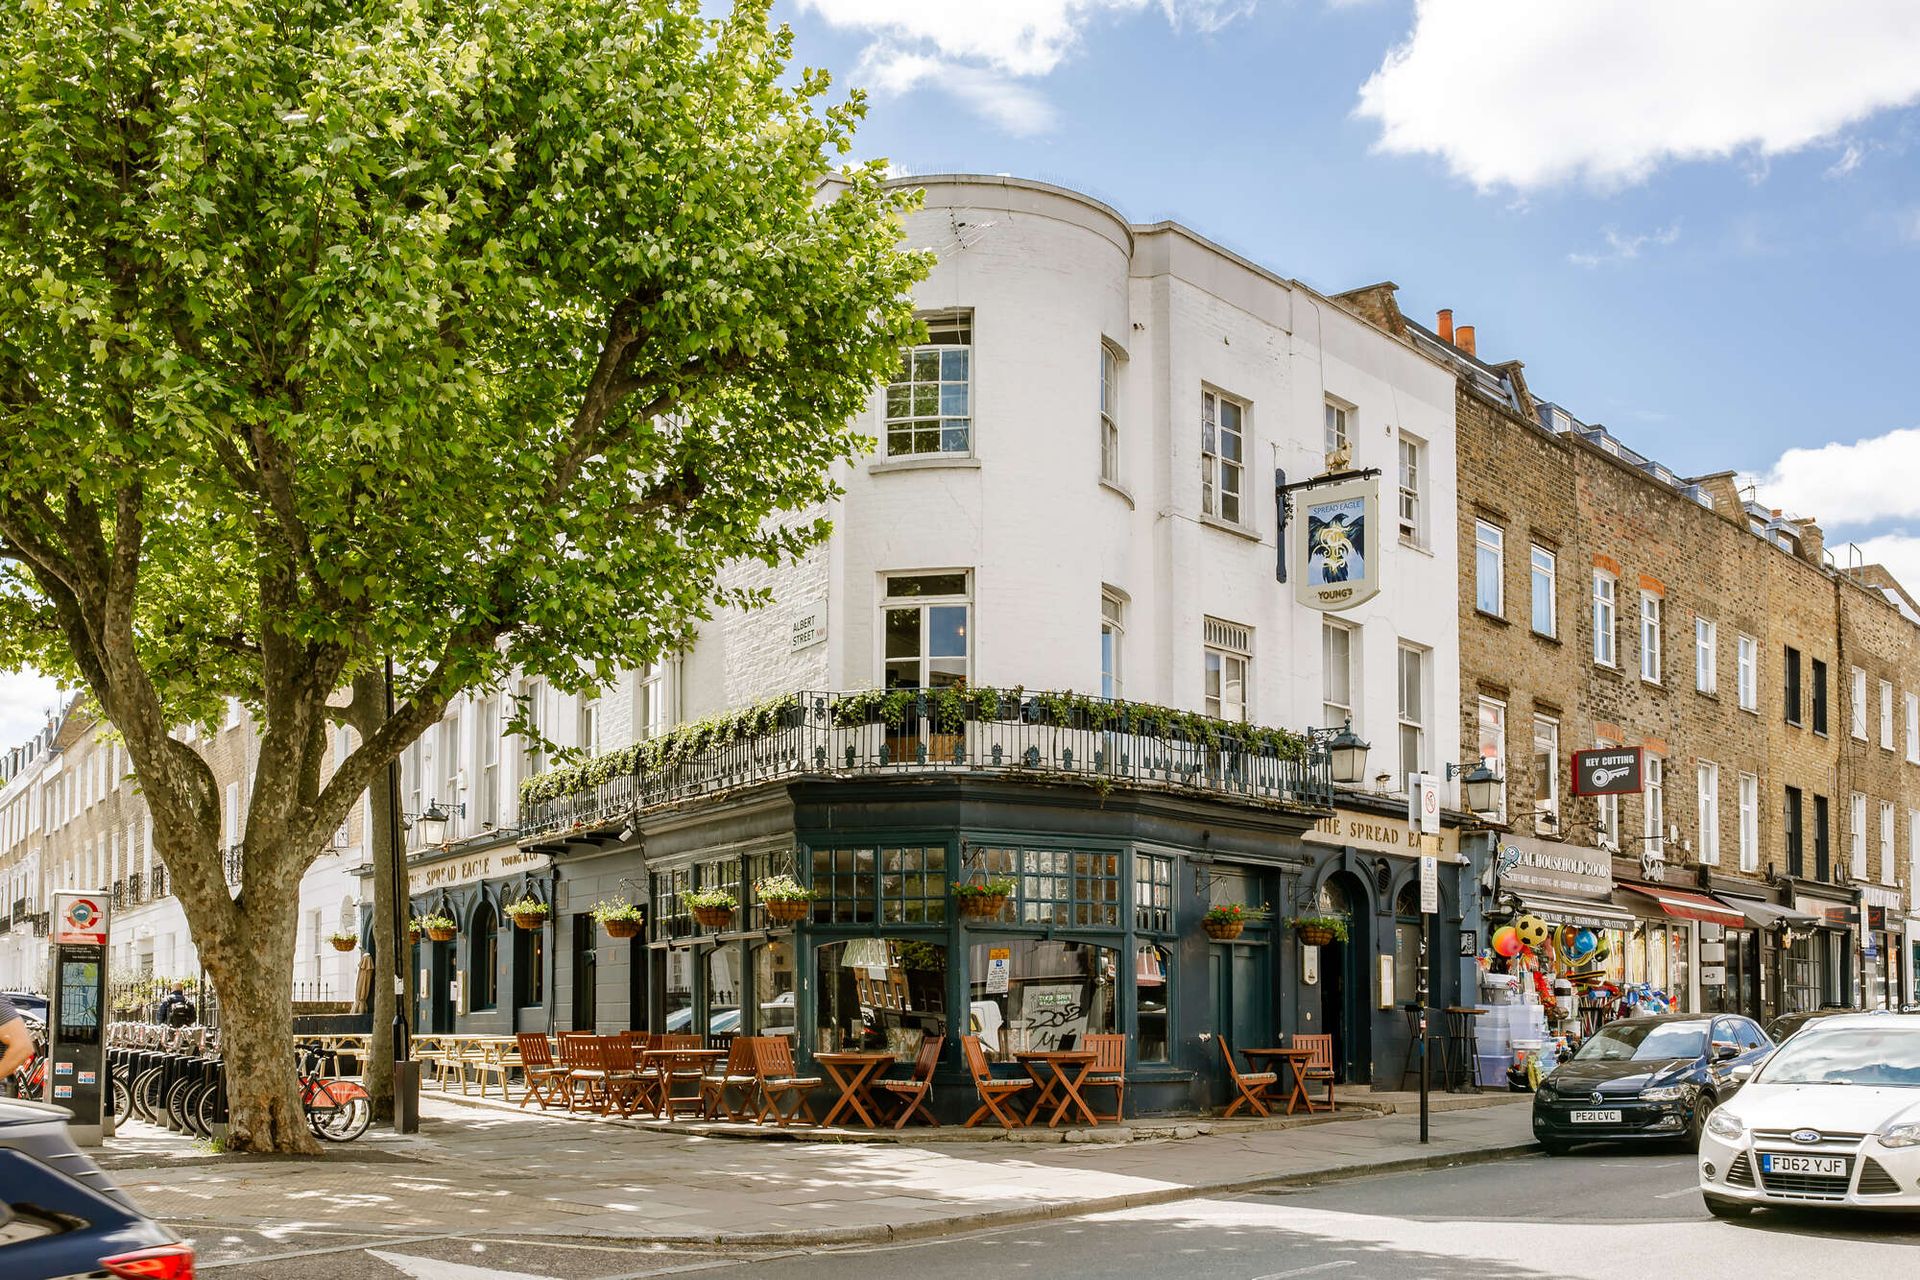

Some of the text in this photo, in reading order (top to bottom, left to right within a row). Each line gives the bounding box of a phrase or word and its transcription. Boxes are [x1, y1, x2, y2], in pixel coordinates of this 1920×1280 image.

[1313, 501, 1360, 514] SPREAD EAGLE
[1318, 588, 1353, 600] YOUNG'S
[793, 615, 815, 633] ALBERT
[793, 629, 815, 646] STREET
[1586, 755, 1634, 767] KEY CUTTING
[1316, 817, 1444, 852] THE SPREAD EAE
[426, 865, 456, 886] SPREAD
[462, 857, 490, 879] EAGLE
[1535, 852, 1584, 874] HOUSEHOLD
[1585, 863, 1610, 878] GOODS
[1576, 1112, 1615, 1121] PE21 CVC
[1772, 1157, 1842, 1173] FD62 YJF
